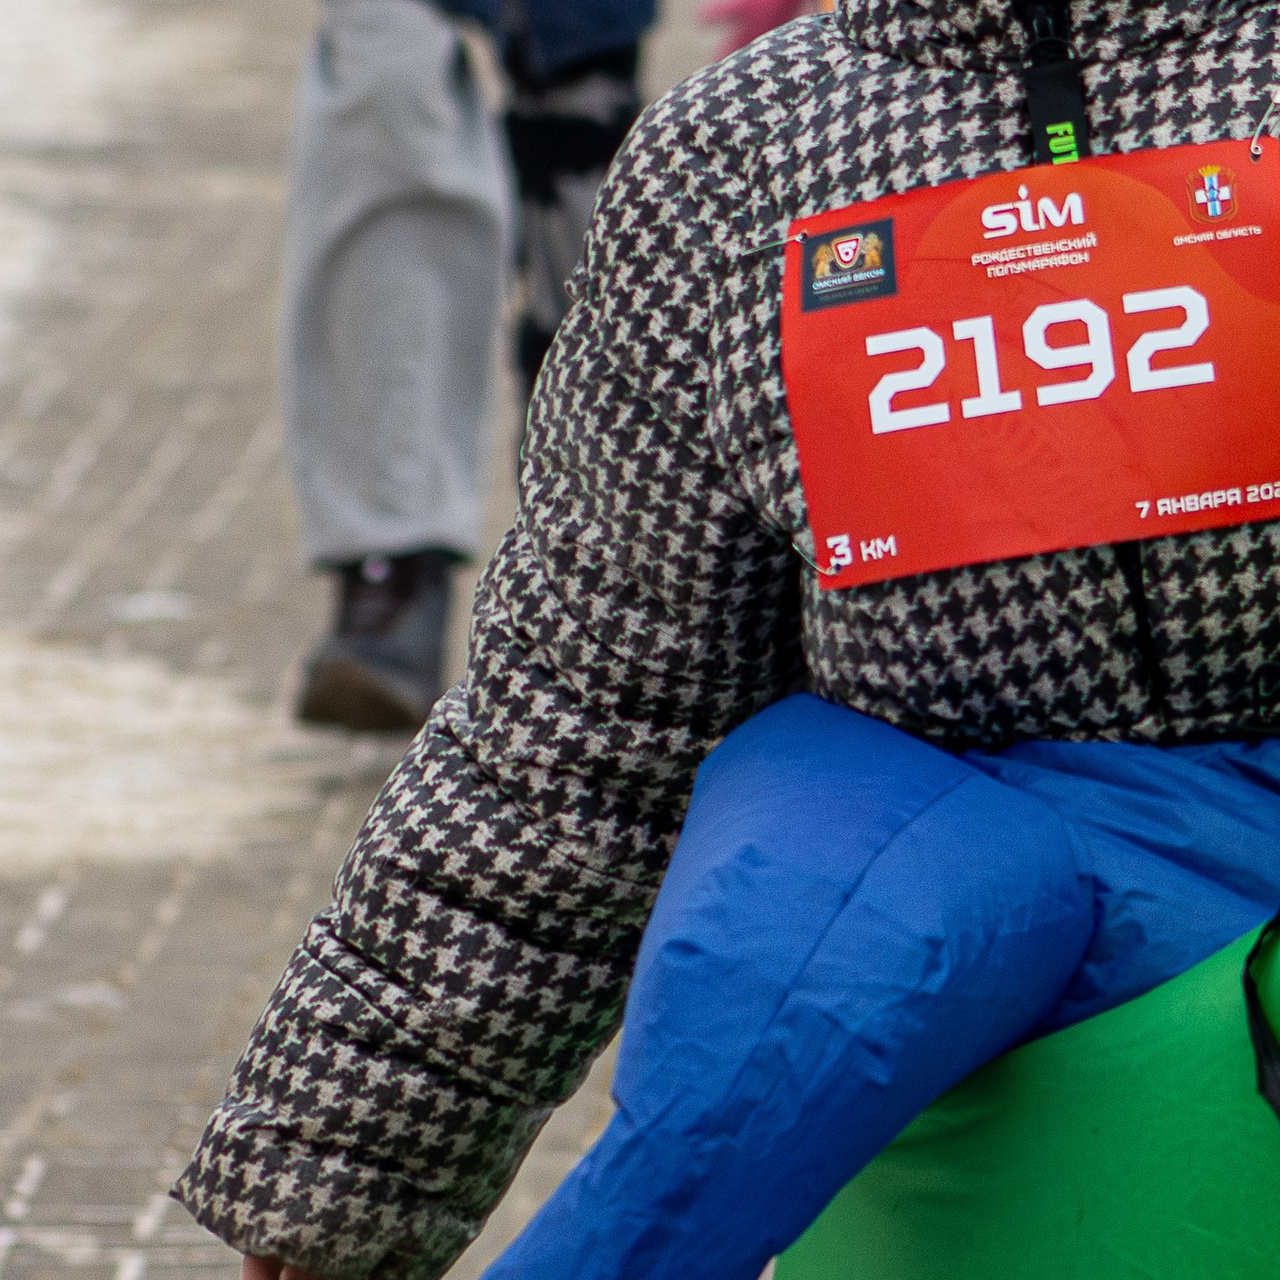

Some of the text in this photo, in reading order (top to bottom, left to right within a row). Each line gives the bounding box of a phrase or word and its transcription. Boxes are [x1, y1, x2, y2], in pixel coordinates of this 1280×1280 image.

[970, 231, 1098, 267] РОЖДЕСТВЕНСКИЙ
[986, 252, 1091, 279] ПОЛУМАРАФОН
[864, 284, 1216, 435] 2192
[1135, 500, 1151, 519] 7
[1156, 486, 1242, 516] ЯНВАРЯ
[826, 533, 898, 567] 3 КМ
